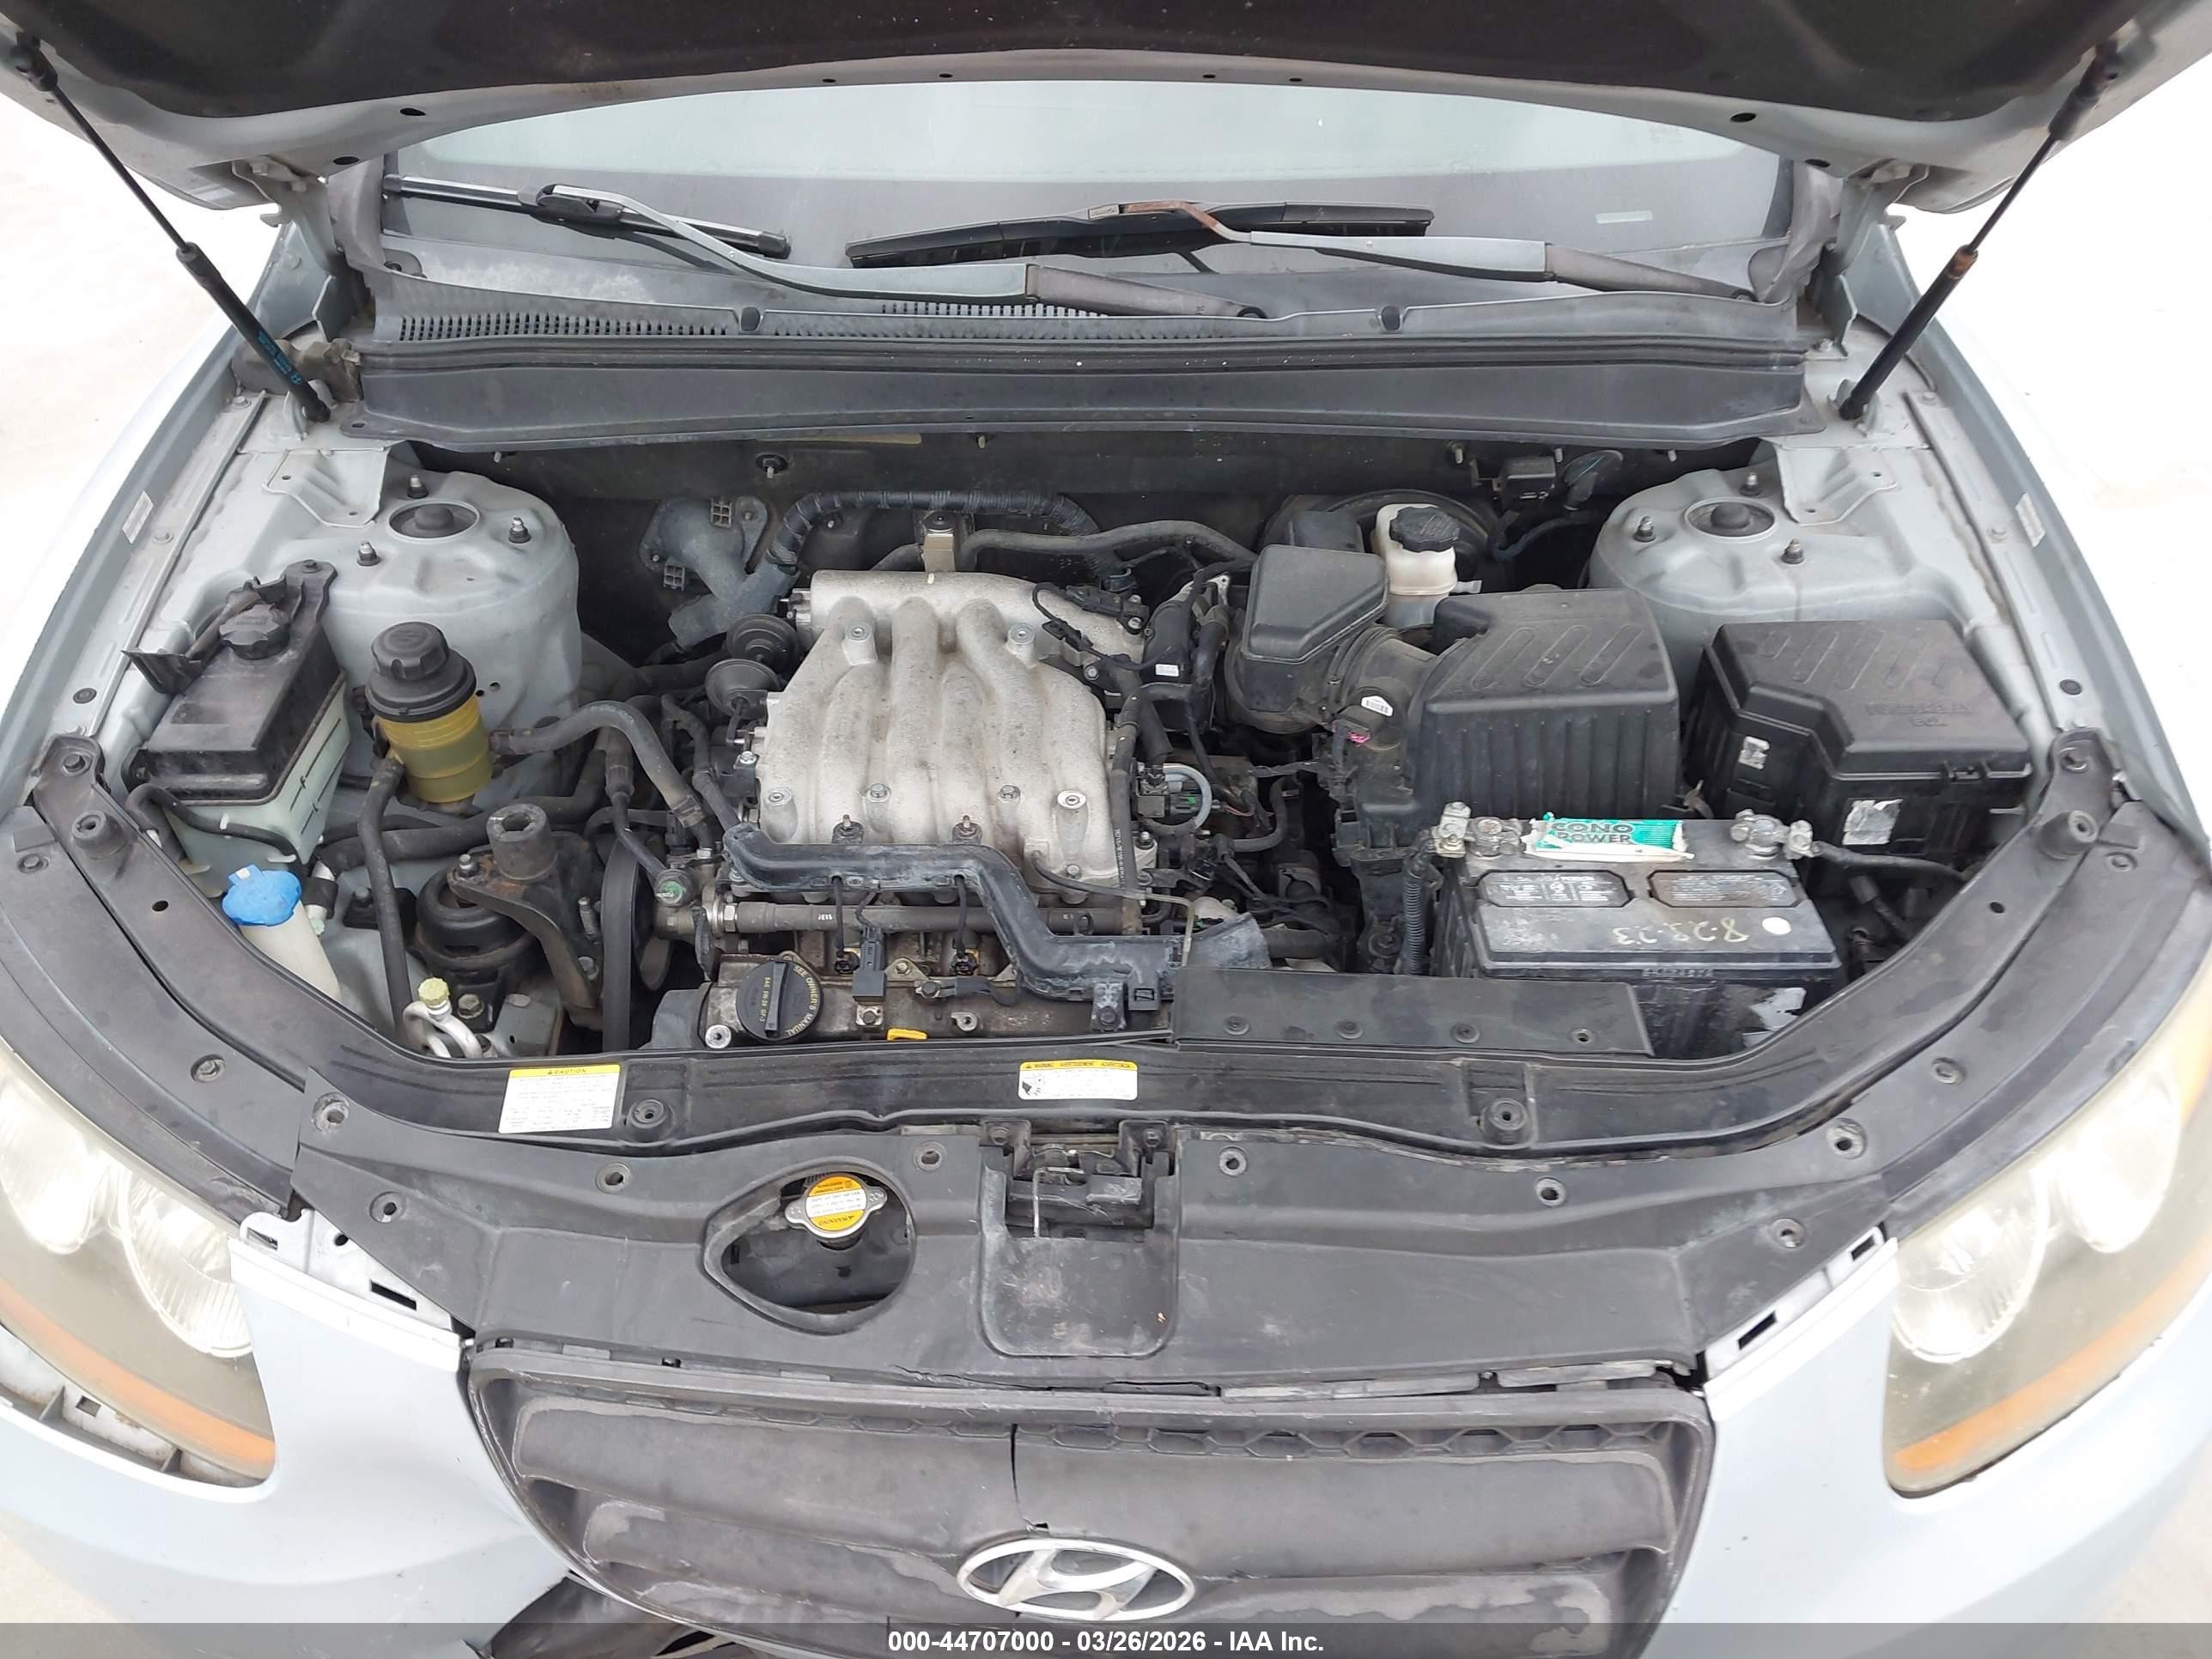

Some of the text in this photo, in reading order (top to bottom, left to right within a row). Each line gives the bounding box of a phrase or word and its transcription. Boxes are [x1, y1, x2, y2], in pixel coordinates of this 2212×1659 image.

[1556, 832, 1631, 843] POWER
[793, 965, 808, 977] SEE
[785, 1012, 813, 1036] MANUAL
